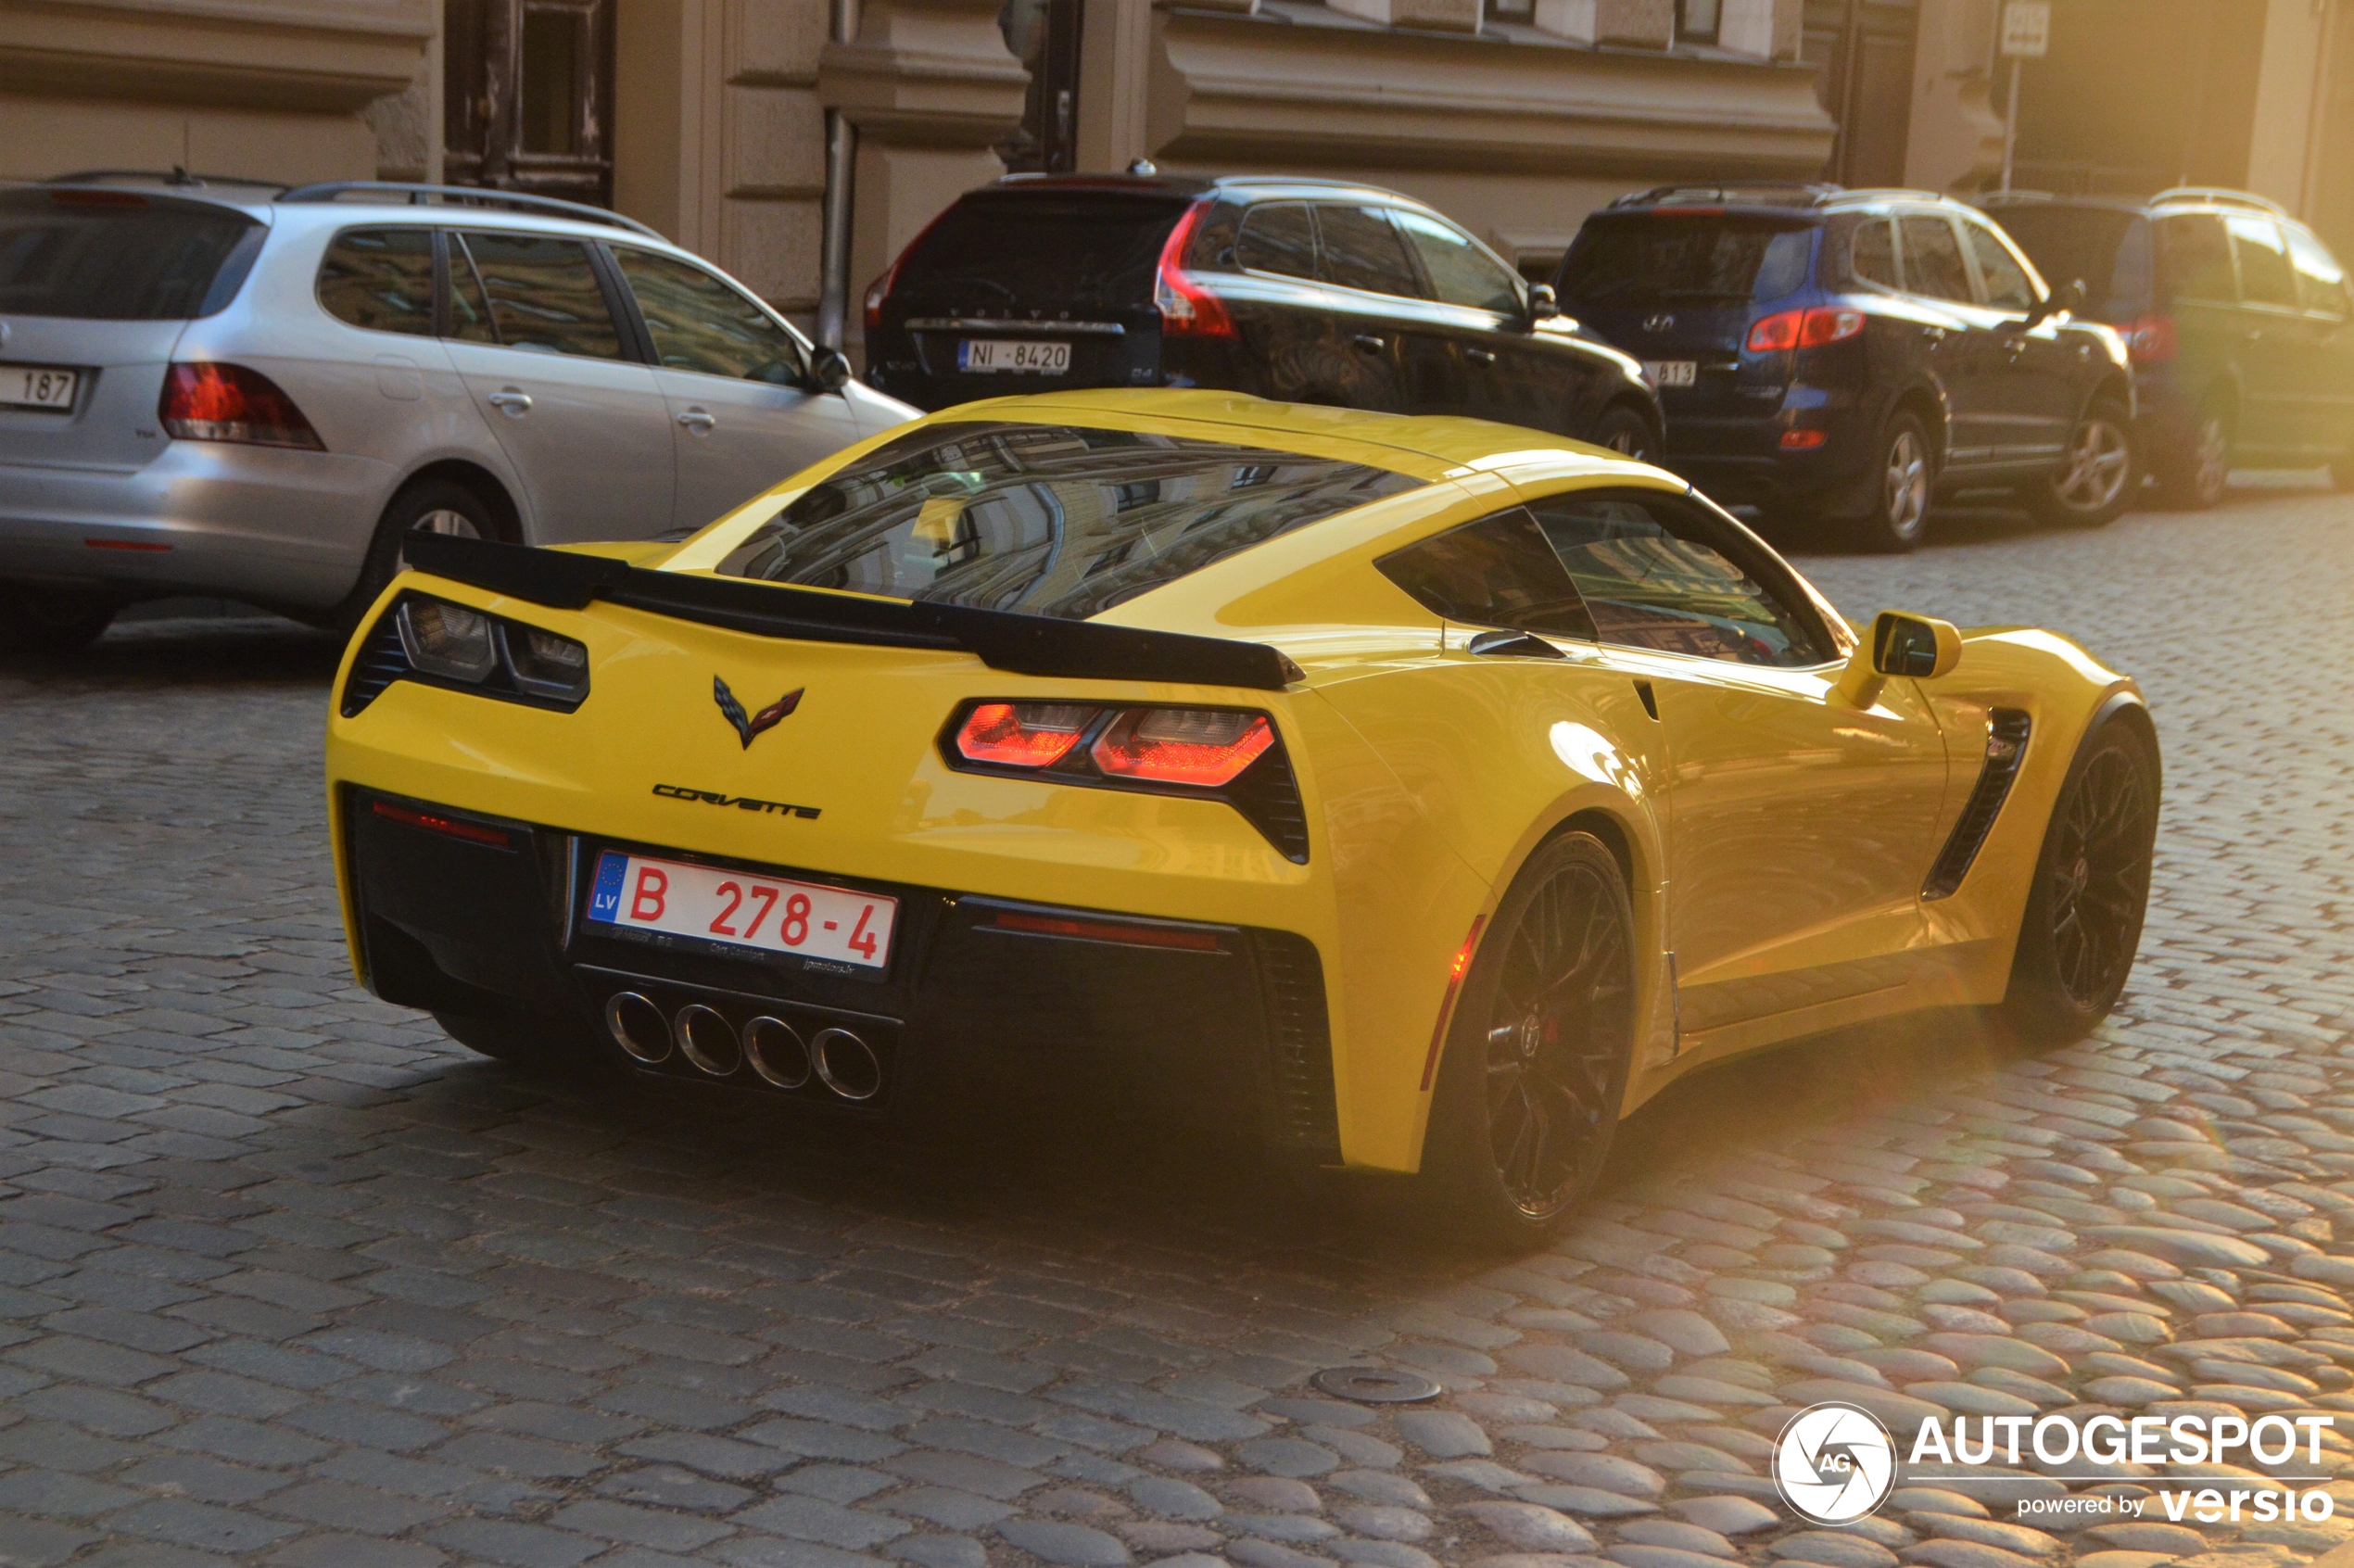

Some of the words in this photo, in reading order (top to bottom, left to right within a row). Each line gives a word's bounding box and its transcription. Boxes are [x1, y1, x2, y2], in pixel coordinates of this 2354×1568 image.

[24, 372, 70, 402] 187
[652, 783, 822, 820] CORVETTE
[595, 892, 617, 909] LV
[630, 866, 668, 921] B
[709, 881, 877, 960] 278-4
[803, 958, 855, 975] jpmotors.lv
